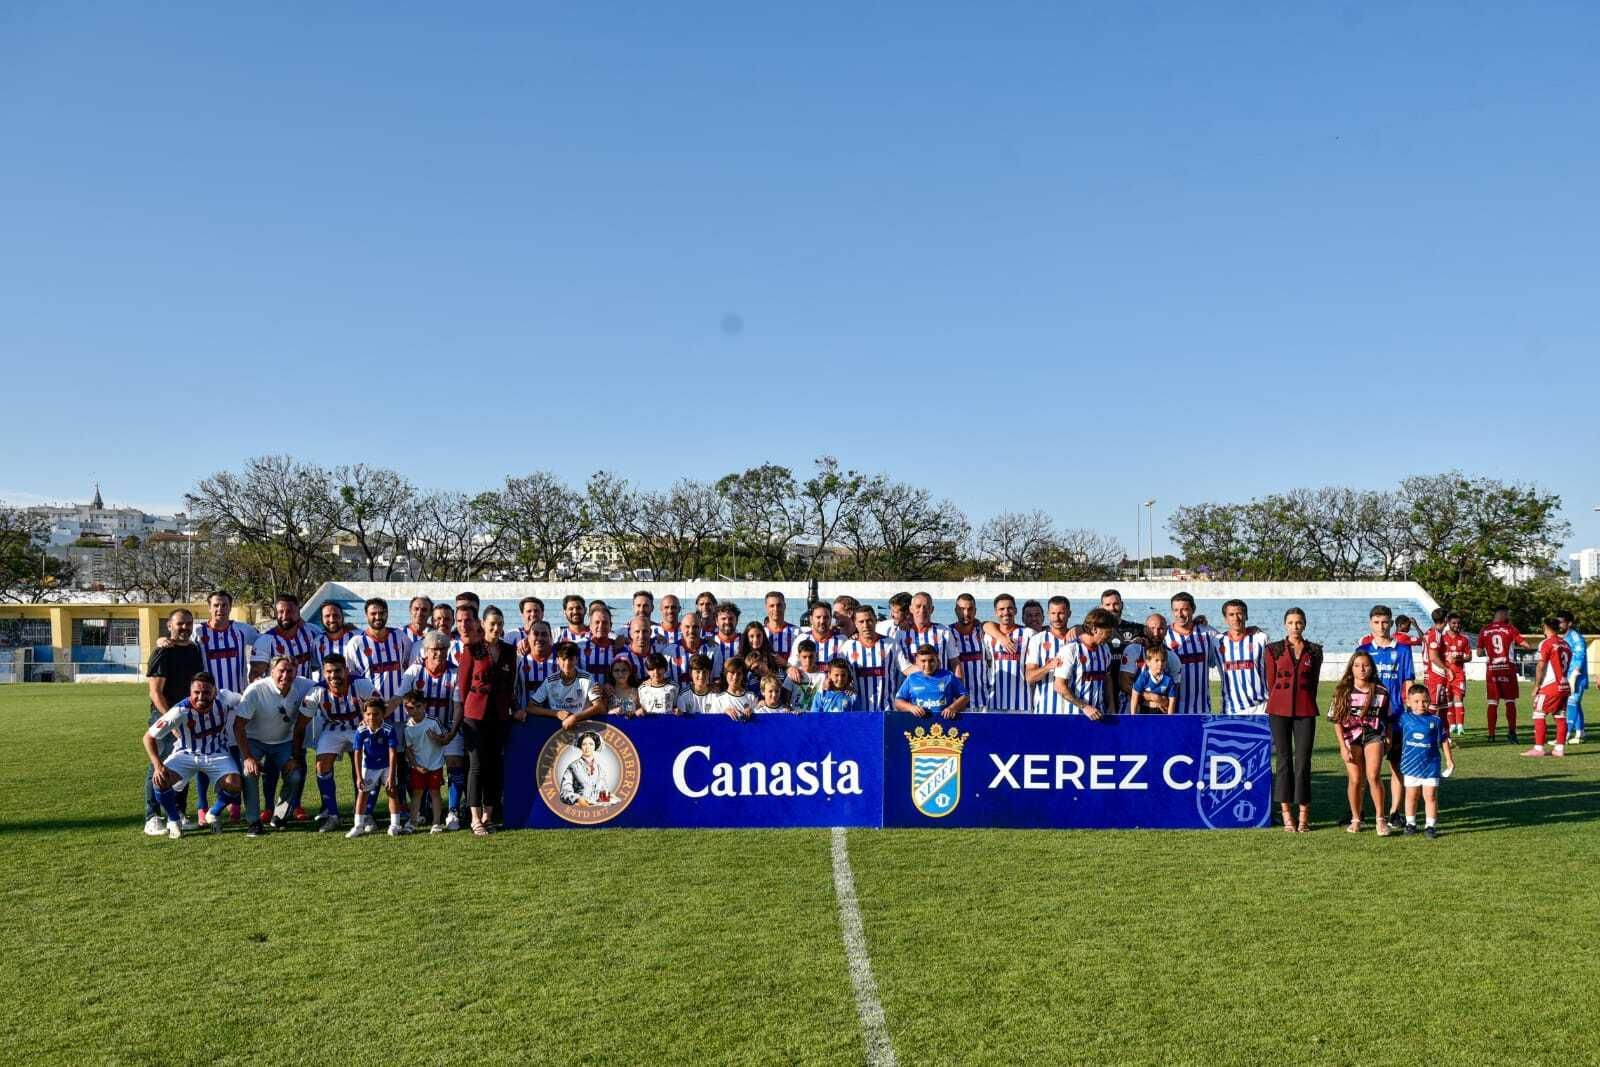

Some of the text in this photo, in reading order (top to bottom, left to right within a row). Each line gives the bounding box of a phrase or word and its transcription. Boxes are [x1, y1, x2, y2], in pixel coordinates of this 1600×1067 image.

[1491, 634, 1504, 654] 9
[603, 729, 637, 801] HUMBERT
[672, 745, 863, 799] Canasta
[916, 758, 957, 802] XEREZ
[988, 754, 1253, 790] XEREZ C.D.
